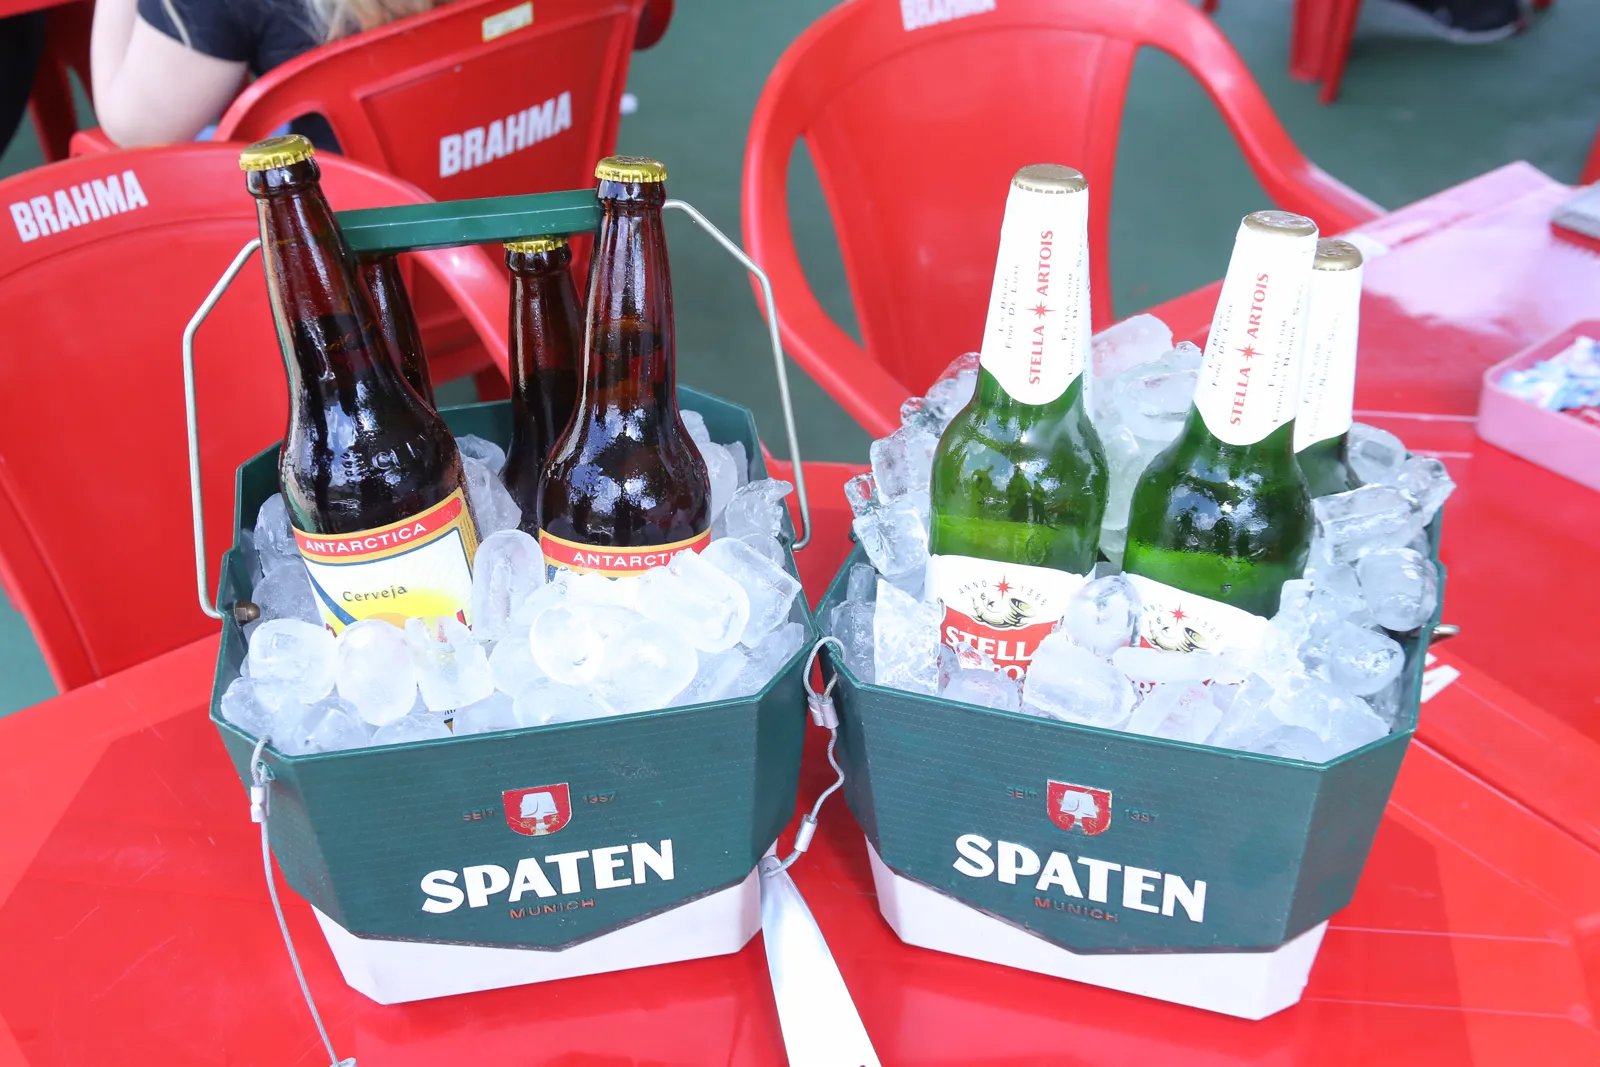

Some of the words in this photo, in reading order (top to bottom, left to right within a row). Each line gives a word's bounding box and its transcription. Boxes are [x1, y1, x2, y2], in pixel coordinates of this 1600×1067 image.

[439, 91, 572, 178] BRAHMA
[9, 170, 148, 243] BRAHMA
[1036, 230, 1054, 297] ARTOIS
[1028, 324, 1046, 386] STELLA
[1230, 366, 1252, 427] STELLA
[1246, 272, 1270, 343] ARTOIS
[305, 522, 427, 553] ANTARCTICA
[573, 549, 682, 567] ANTARCT
[342, 585, 408, 603] Cerveja
[958, 580, 987, 595] ANNO
[1019, 585, 1047, 606] 1366
[945, 625, 1032, 661] STELL
[1005, 786, 1038, 800] SEIT
[462, 805, 496, 821] SEIT
[420, 838, 676, 914] SPATEN
[952, 833, 1208, 923] SPATEN
[508, 898, 596, 920] MUNICH
[1033, 896, 1119, 923] MUNICH
